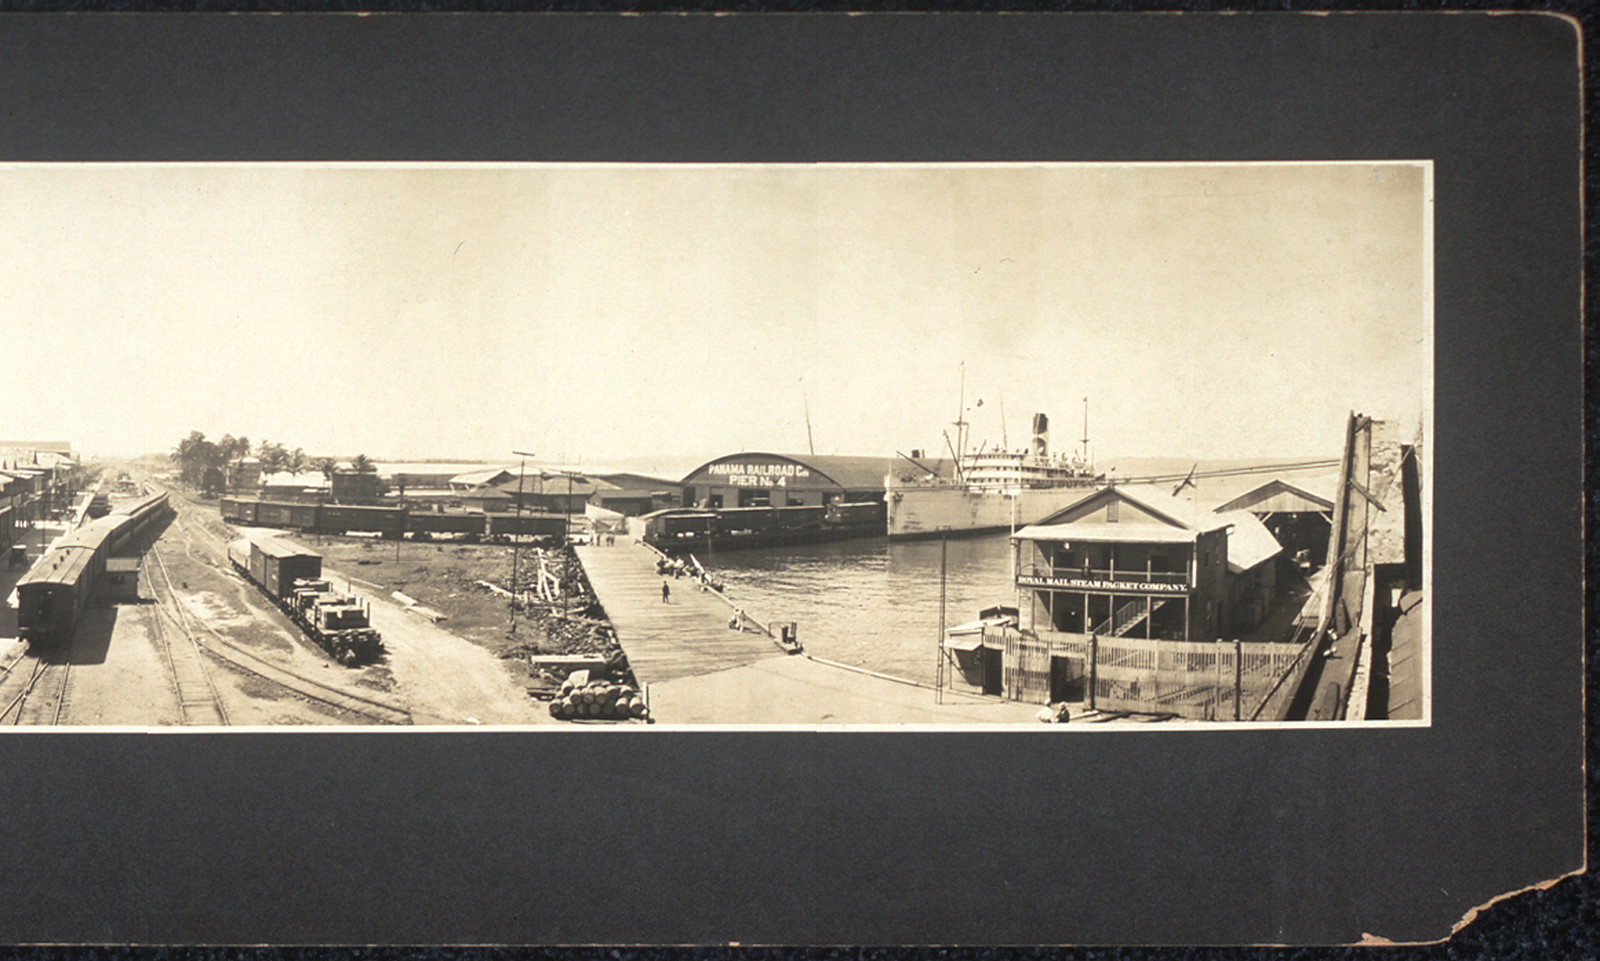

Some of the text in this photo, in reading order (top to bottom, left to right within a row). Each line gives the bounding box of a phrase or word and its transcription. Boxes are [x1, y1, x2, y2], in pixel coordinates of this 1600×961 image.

[708, 464, 745, 475] PANAMA
[746, 464, 795, 477] RAILROAD
[729, 475, 758, 486] PIER
[776, 476, 786, 487] 4
[1017, 575, 1046, 585] ROYAL
[1046, 577, 1070, 586] MAIL
[1070, 579, 1101, 588] STEAM
[1102, 580, 1139, 590] PACKET
